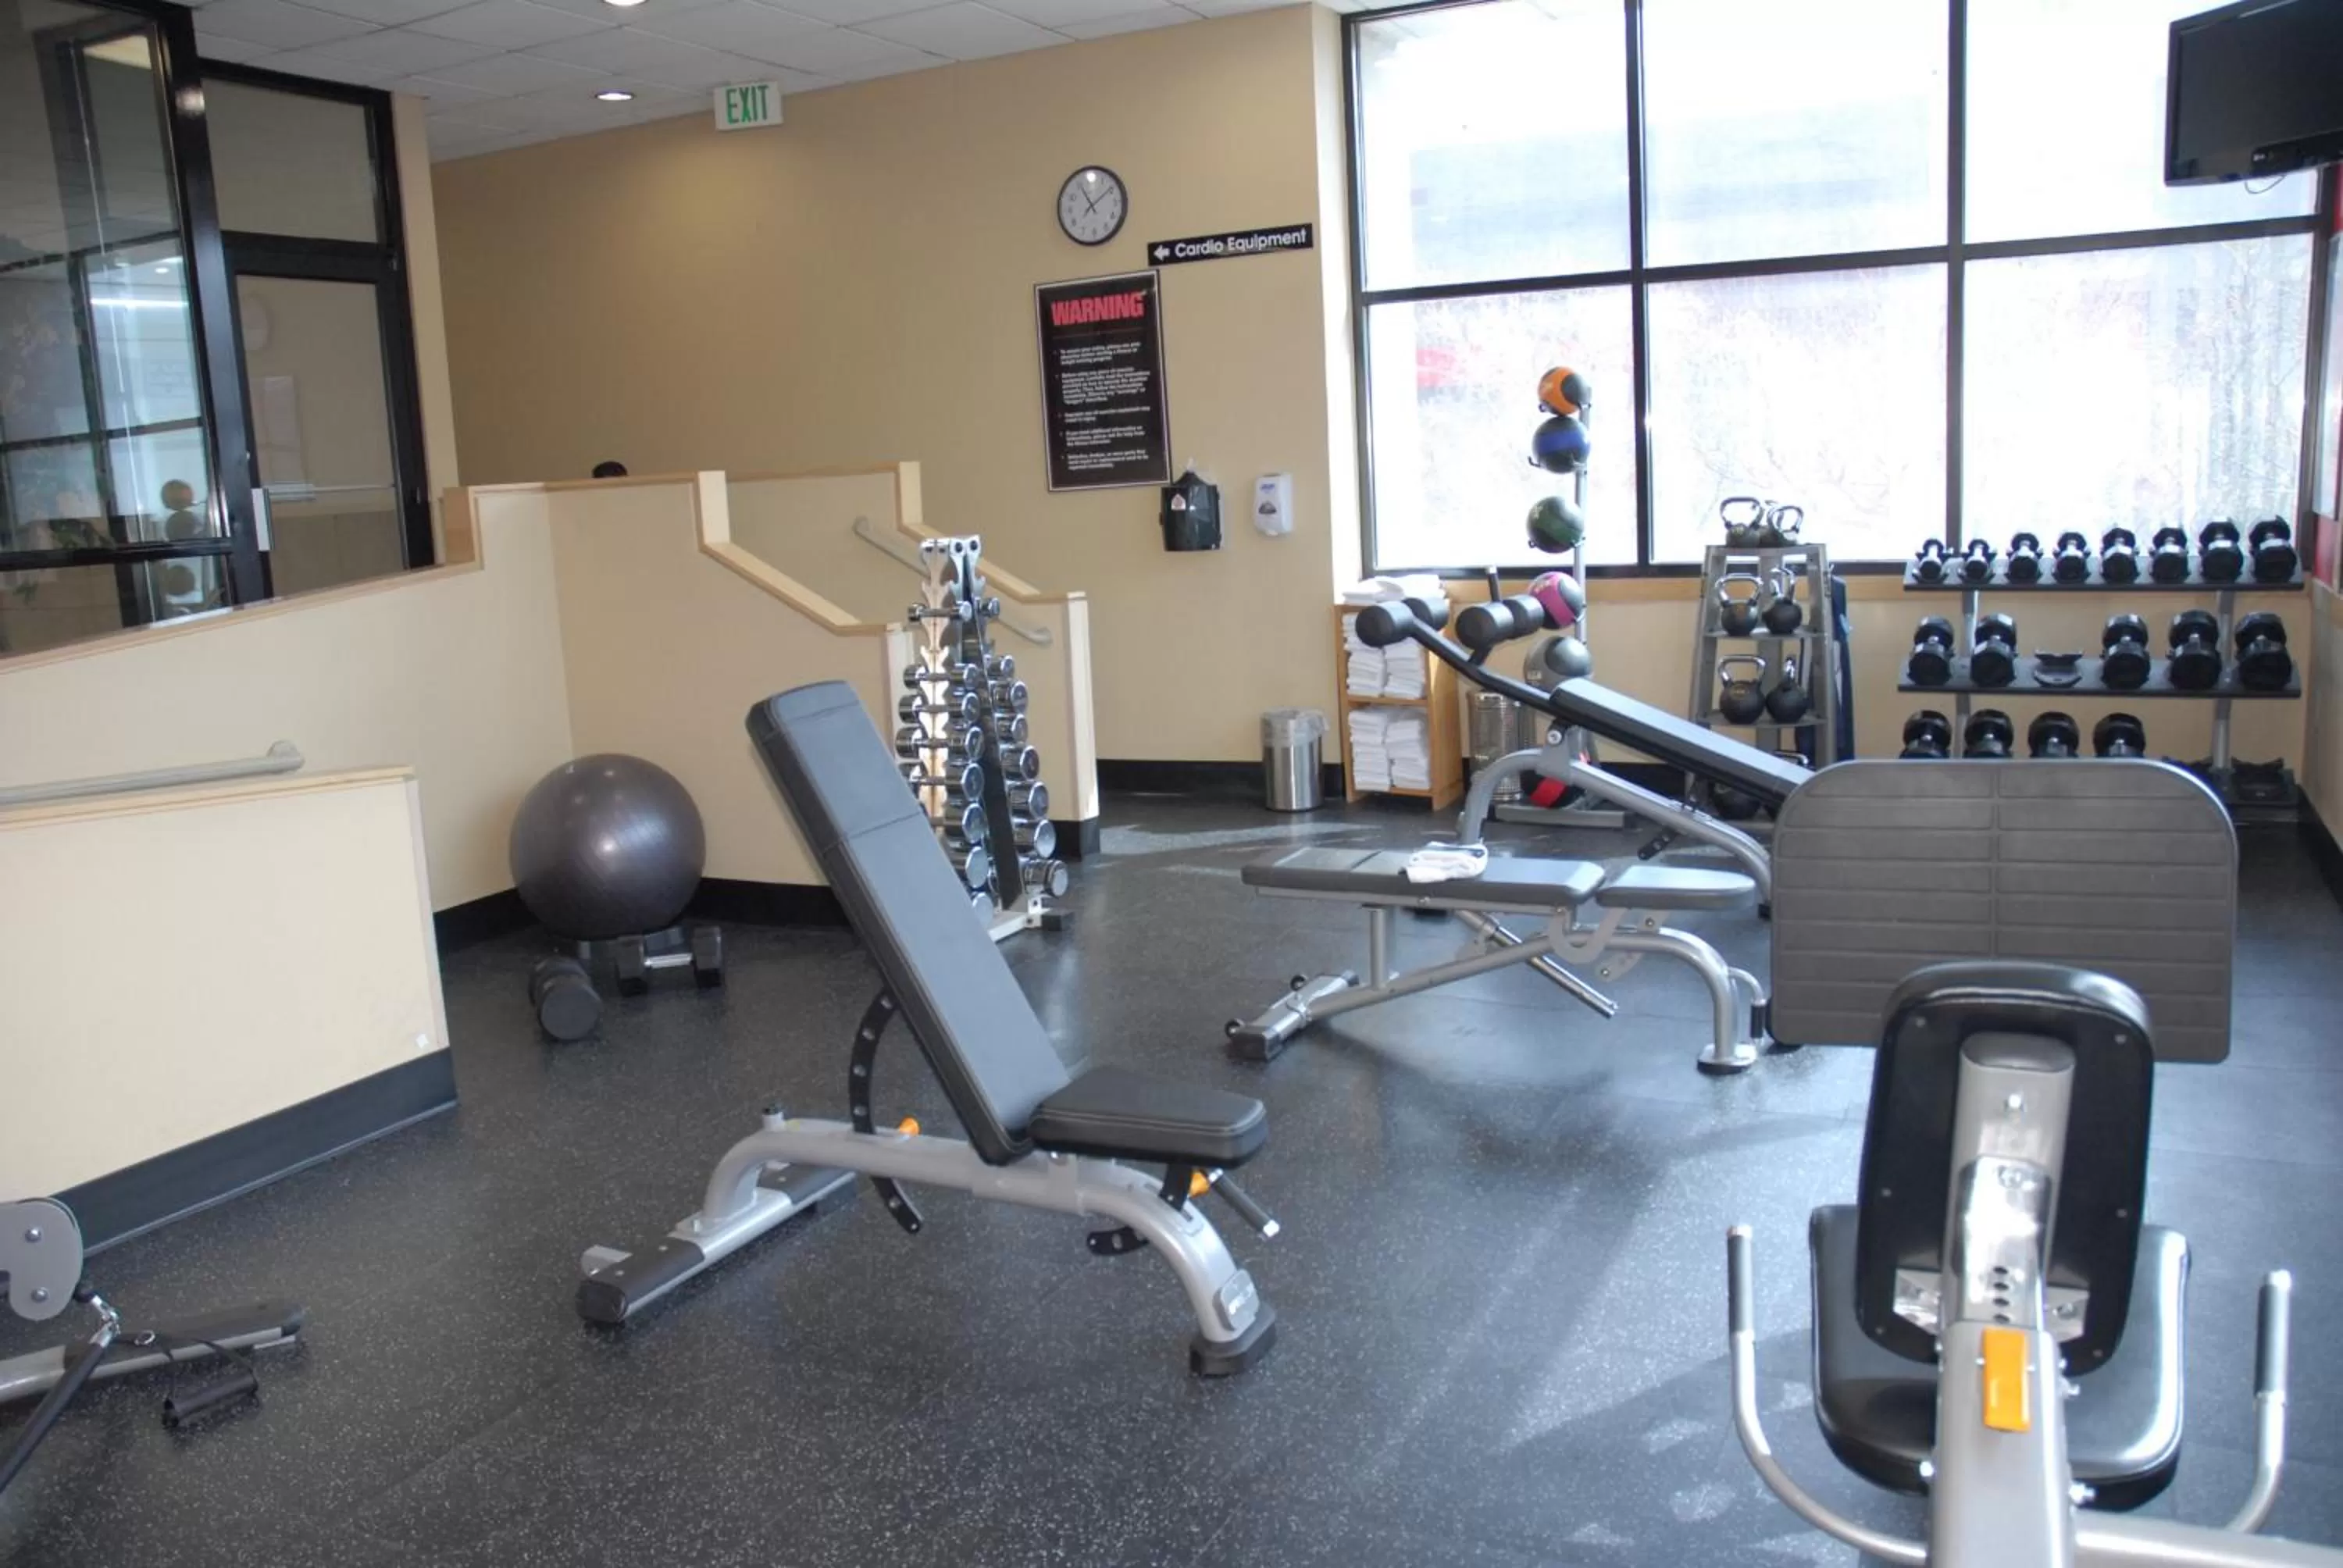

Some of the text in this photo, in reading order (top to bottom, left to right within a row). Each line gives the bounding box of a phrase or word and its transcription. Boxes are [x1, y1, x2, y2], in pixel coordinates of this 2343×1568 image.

[726, 84, 769, 124] EXIT
[1175, 228, 1307, 258] Cardio Equipment
[1051, 290, 1144, 326] WARNING
